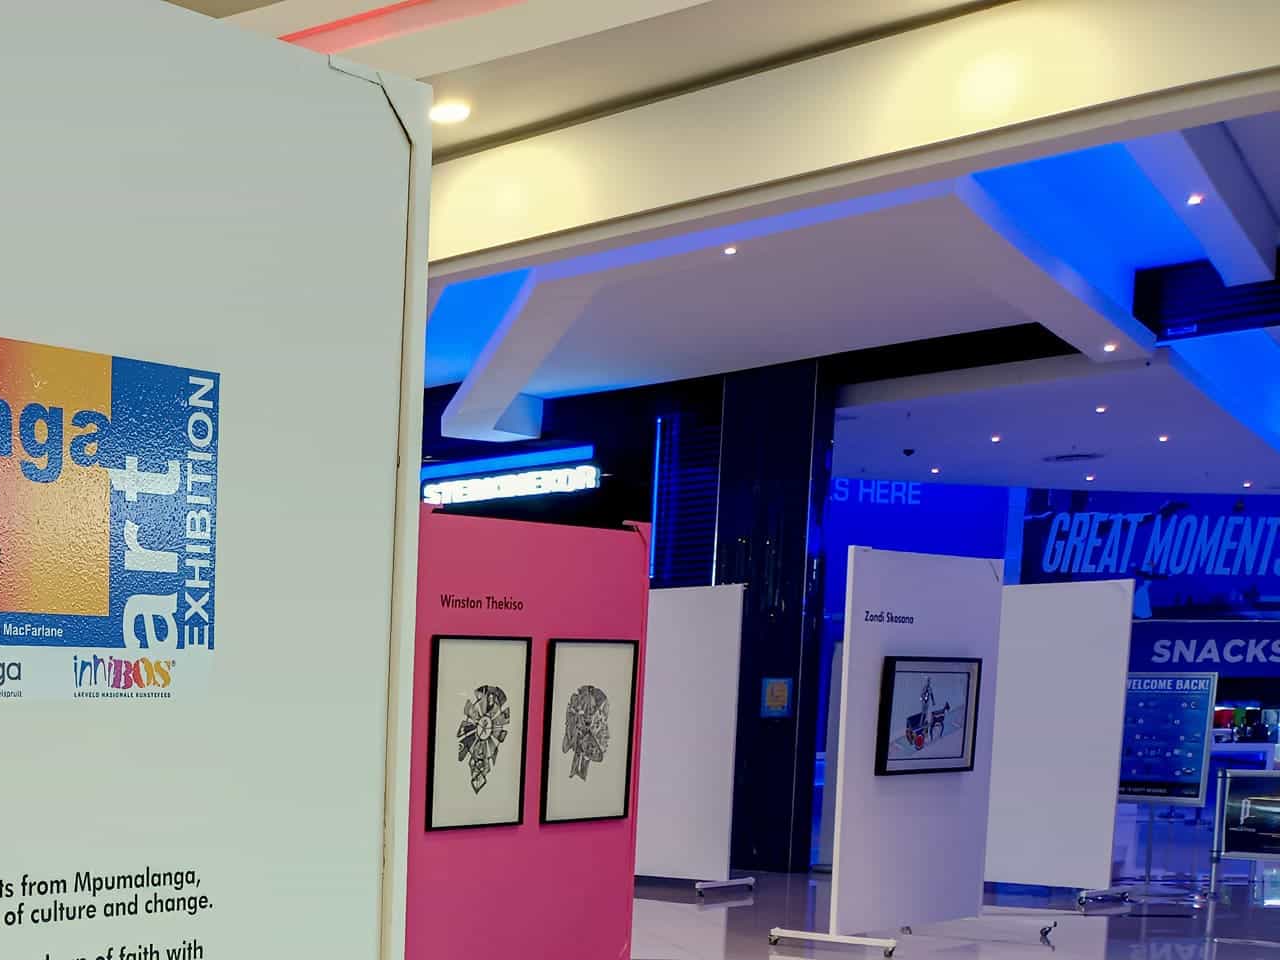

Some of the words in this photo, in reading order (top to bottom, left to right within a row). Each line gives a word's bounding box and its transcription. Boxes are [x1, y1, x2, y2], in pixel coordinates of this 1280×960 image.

[827, 478, 849, 502] S
[859, 479, 921, 505] HERE
[184, 376, 215, 649] EXHIBITION
[107, 456, 181, 649] art
[1041, 512, 1145, 573] GREAT
[440, 594, 482, 609] Winston
[485, 596, 524, 610] Thekiso
[3, 624, 63, 637] MacFarlane
[1176, 679, 1209, 690] BACK!
[21, 874, 67, 897] from
[74, 866, 201, 896] Mpumalanga,
[4, 903, 24, 926] of
[30, 900, 97, 924] culture
[103, 894, 138, 917] and
[145, 892, 213, 915] change.
